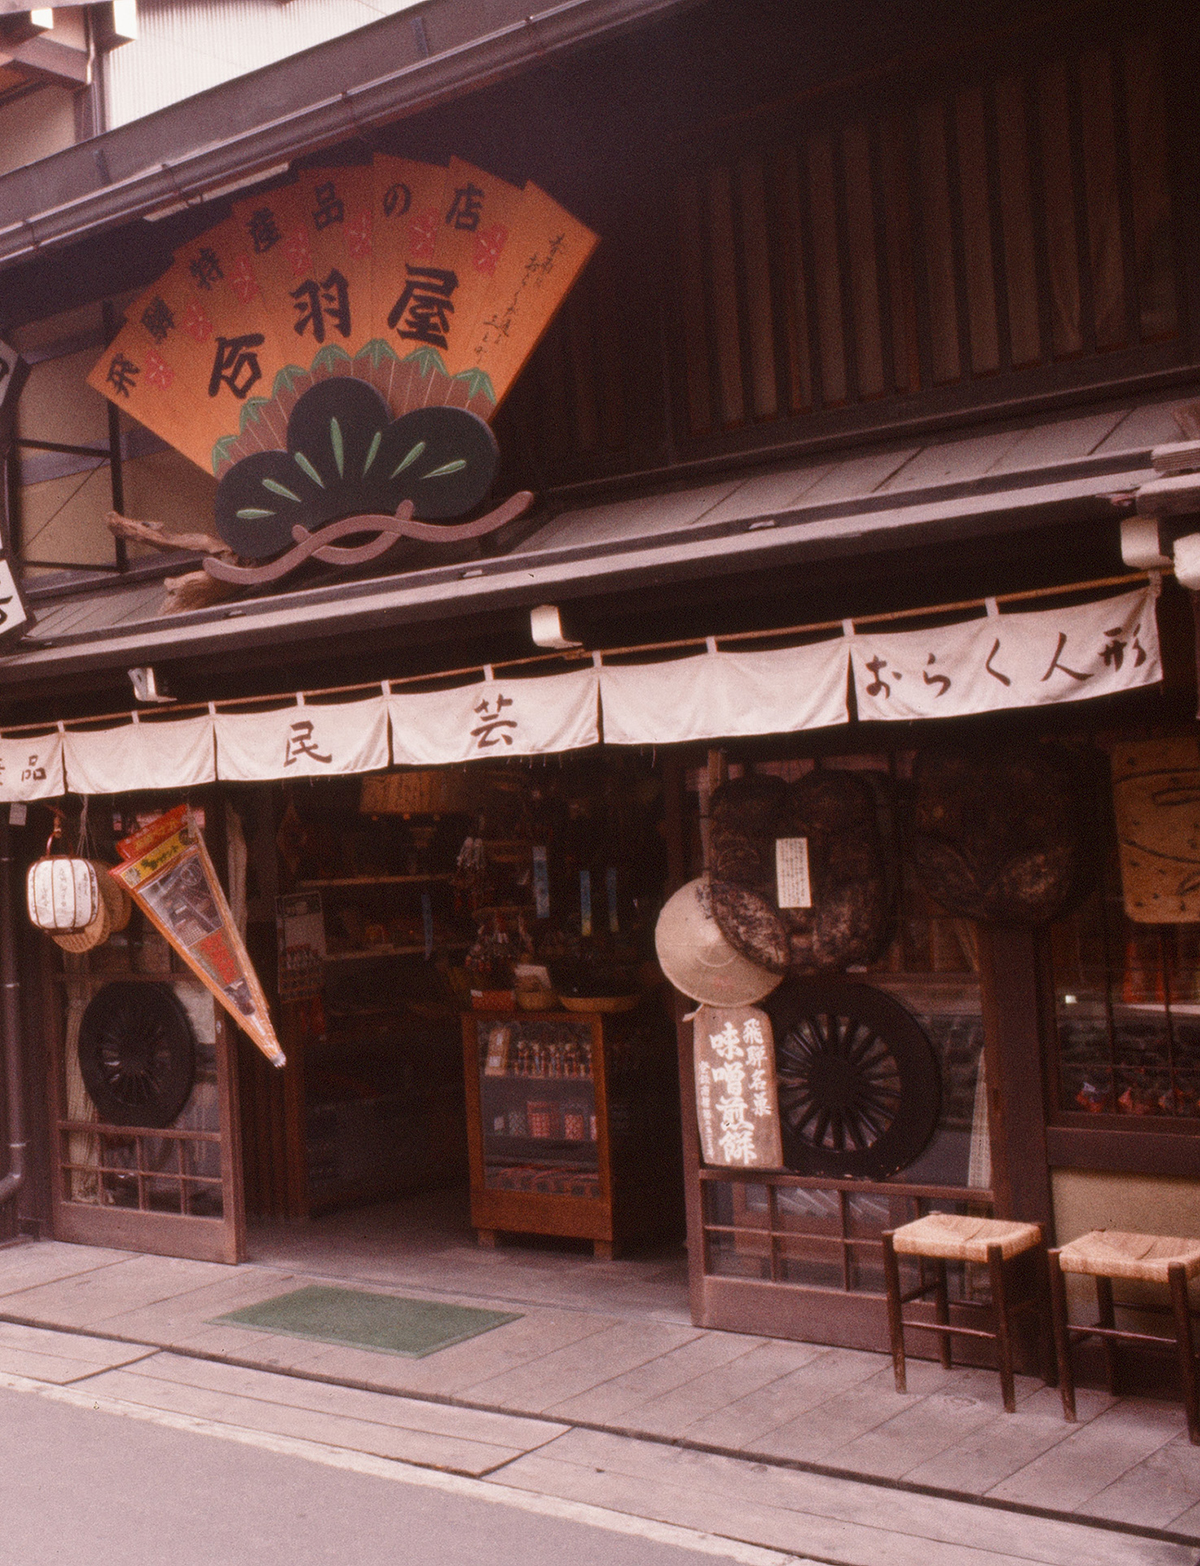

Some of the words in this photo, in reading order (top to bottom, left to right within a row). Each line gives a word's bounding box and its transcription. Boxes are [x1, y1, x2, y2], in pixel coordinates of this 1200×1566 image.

[865, 622, 1147, 700] おらく人形
[709, 1021, 758, 1165] 味噌煎餅
